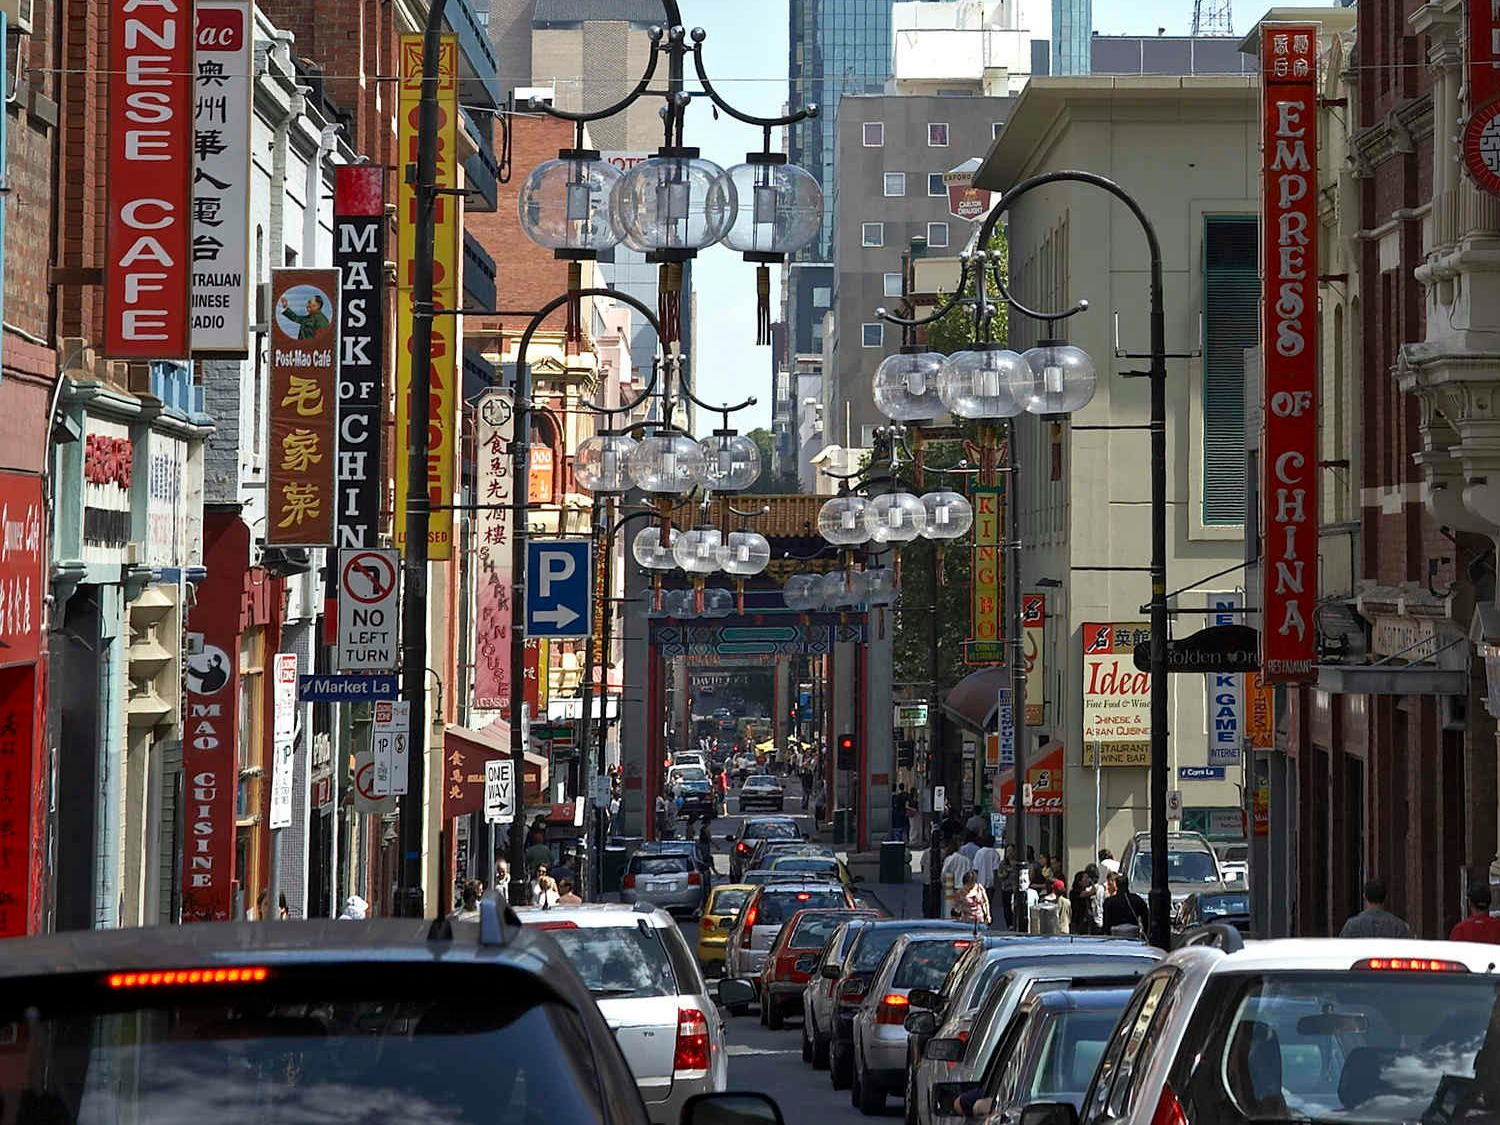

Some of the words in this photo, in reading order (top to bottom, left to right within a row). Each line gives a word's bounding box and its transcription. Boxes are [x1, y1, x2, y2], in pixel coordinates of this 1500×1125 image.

[1270, 101, 1312, 357] EMPRESS
[118, 198, 175, 341] CAFE
[192, 273, 241, 287] TRALIAN
[192, 294, 230, 308] INESE
[338, 224, 378, 366] MASK
[275, 348, 310, 368] Post-Mao
[312, 348, 333, 368] Café
[340, 381, 375, 399] OF
[1271, 391, 1313, 418] OF
[278, 375, 324, 528] 毛家菜
[338, 414, 369, 548] CHIN
[1274, 451, 1307, 643] CHINA
[479, 546, 510, 612] SHARK
[539, 551, 576, 597] P
[353, 609, 384, 627] NO
[349, 631, 388, 644] LEFT
[346, 649, 388, 662] TURN
[478, 631, 509, 696] HOUSE
[313, 679, 369, 693] Market
[372, 679, 390, 693] La
[1085, 661, 1152, 695] Idea
[190, 704, 221, 750] MAO
[1215, 693, 1237, 742] GAME
[1086, 744, 1150, 754] RSTAURANT
[1126, 754, 1147, 763] BAR
[488, 766, 509, 781] ONE
[488, 784, 510, 800] WAY
[191, 772, 217, 887] CUISINE
